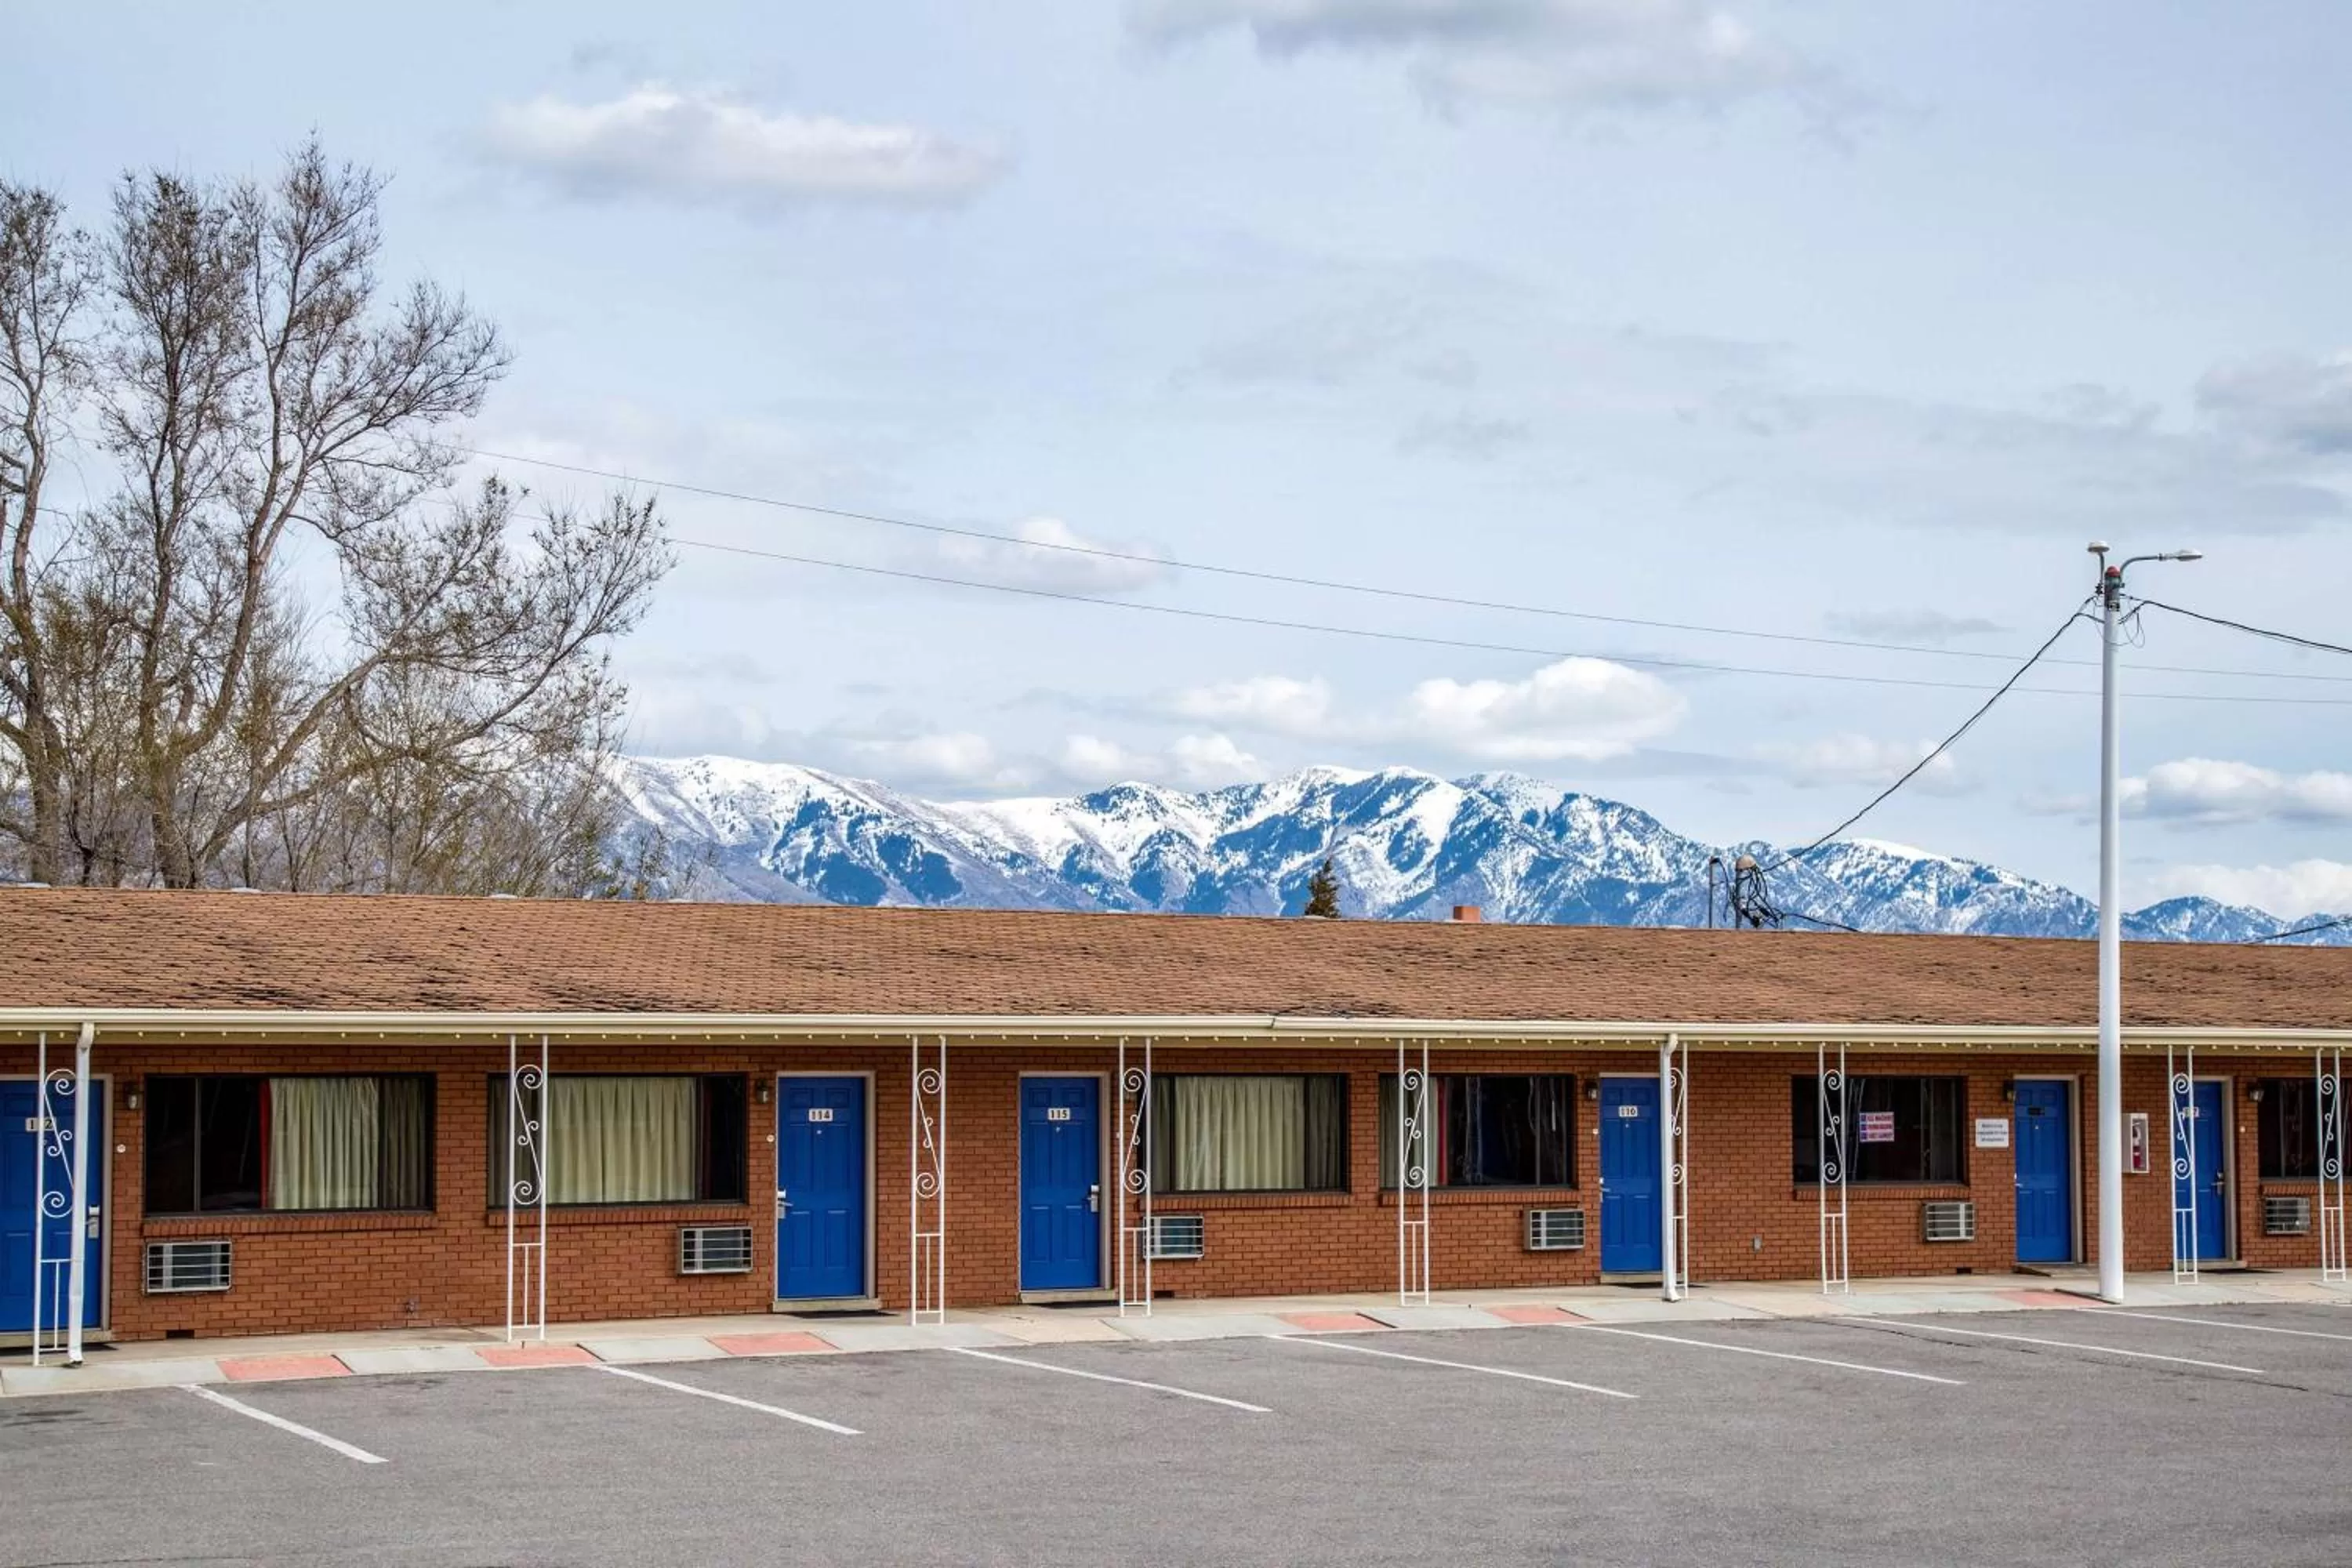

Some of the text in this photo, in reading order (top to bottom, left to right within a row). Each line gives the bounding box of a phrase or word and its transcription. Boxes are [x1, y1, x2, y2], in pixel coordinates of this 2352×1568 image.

[811, 1109, 830, 1120] 114
[1051, 1109, 1068, 1119] 115
[30, 1118, 53, 1130] 12
